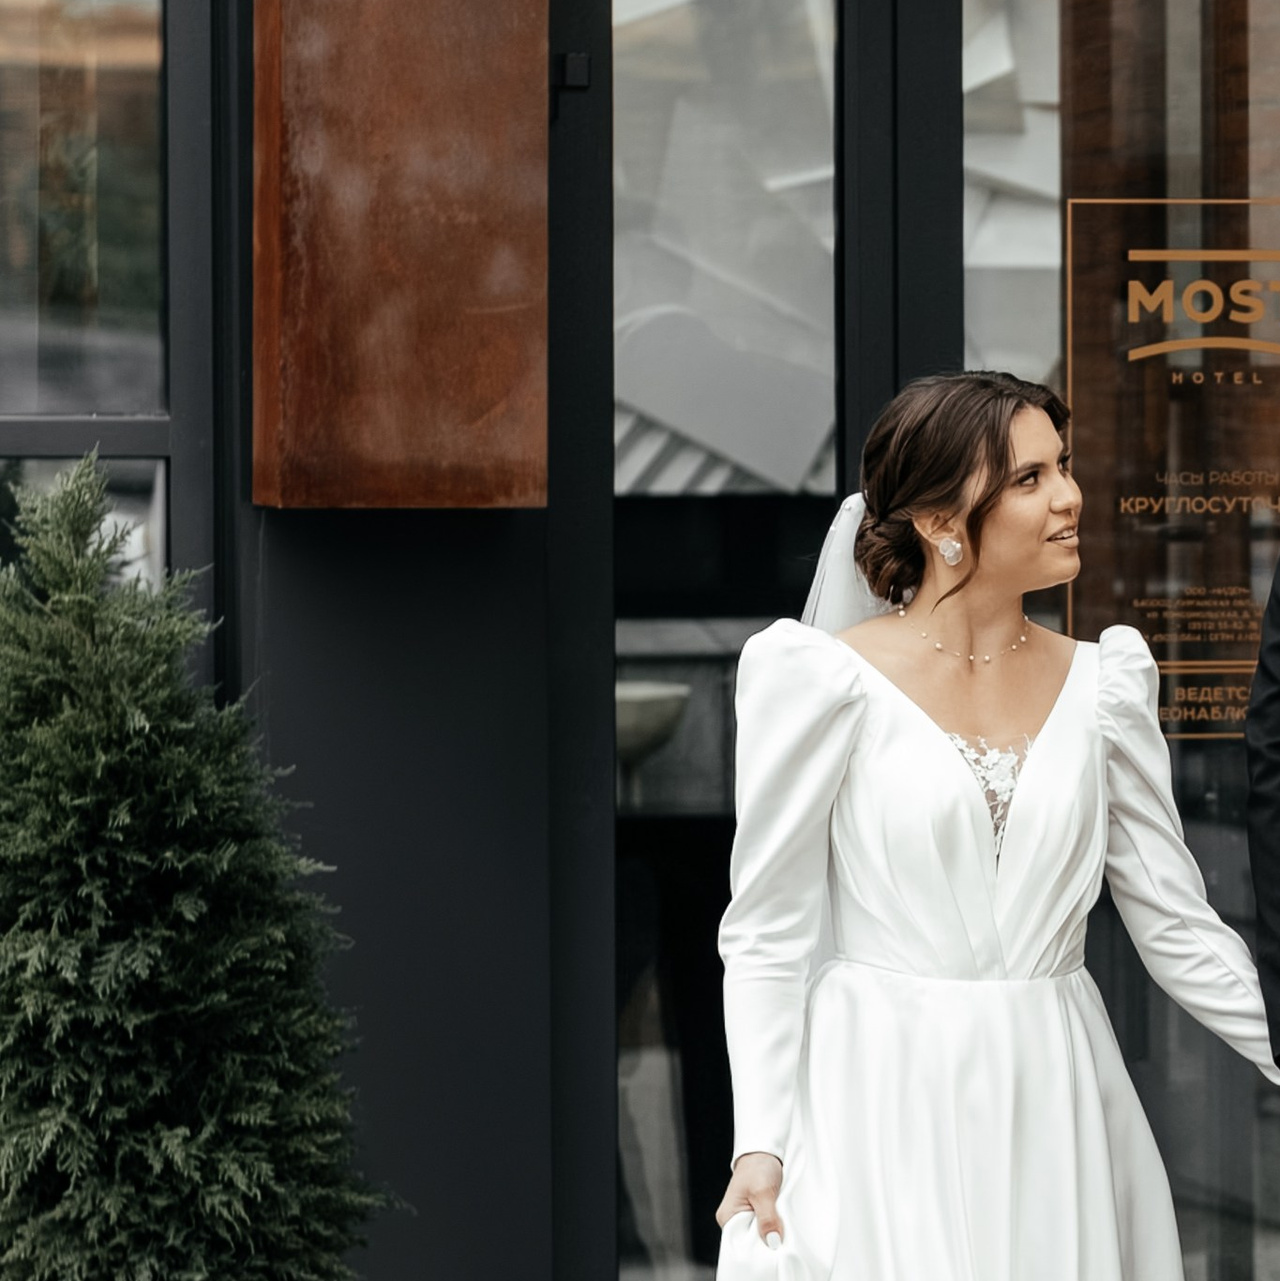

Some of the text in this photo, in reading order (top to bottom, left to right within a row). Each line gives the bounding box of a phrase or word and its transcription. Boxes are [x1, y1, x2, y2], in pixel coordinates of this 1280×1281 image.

[1171, 371, 1263, 385] HOTEL
[1155, 470, 1280, 486] ЧАСЫ РАБОТЫ
[1174, 686, 1251, 702] ВЕДЕТС
